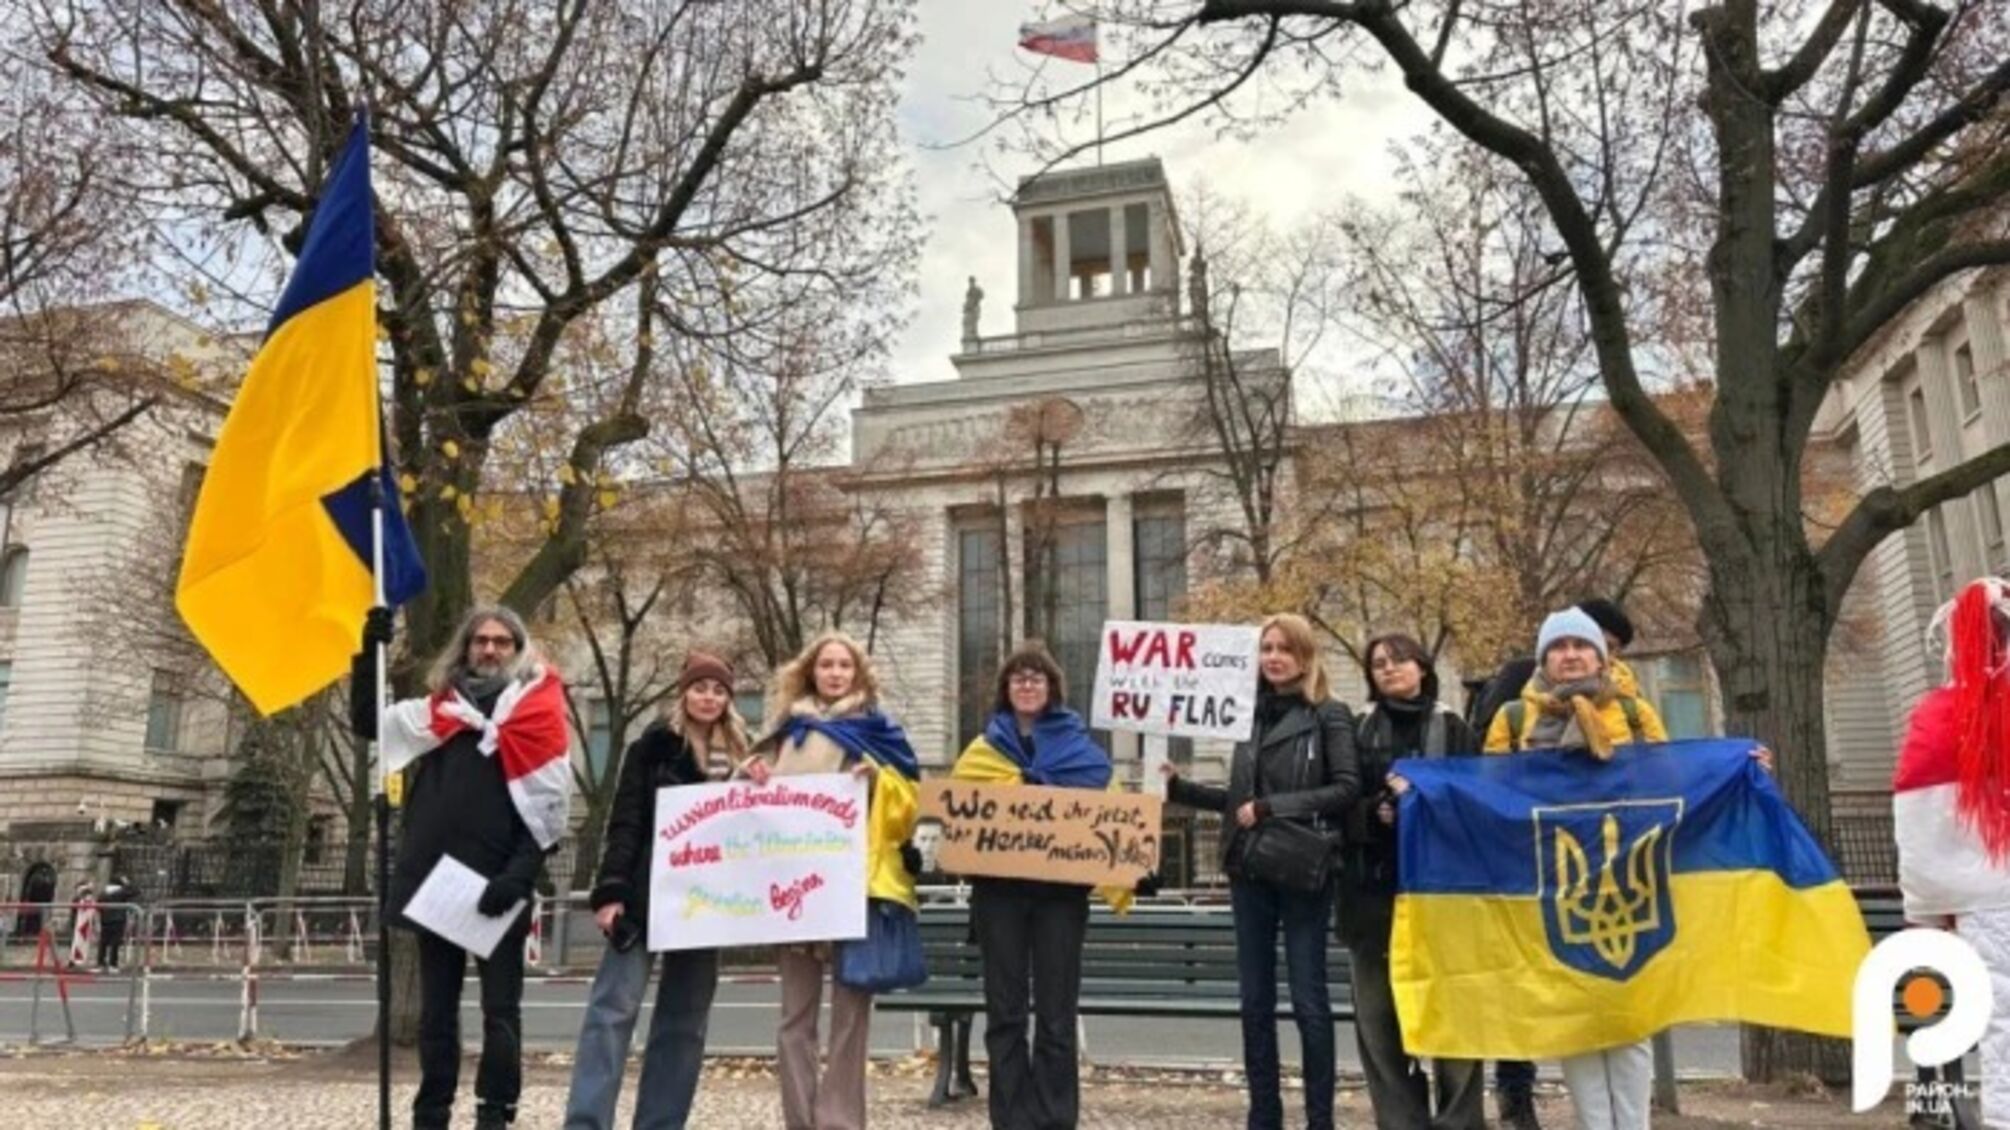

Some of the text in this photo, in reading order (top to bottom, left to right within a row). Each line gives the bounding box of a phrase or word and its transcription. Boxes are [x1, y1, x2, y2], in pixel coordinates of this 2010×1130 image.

[1110, 630, 1249, 670] WAR comes
[1111, 691, 1237, 727] RU FLAG
[811, 793, 858, 828] ends
[940, 790, 998, 820] Wo
[1009, 799, 1056, 821] seid
[1064, 801, 1090, 819] ihr
